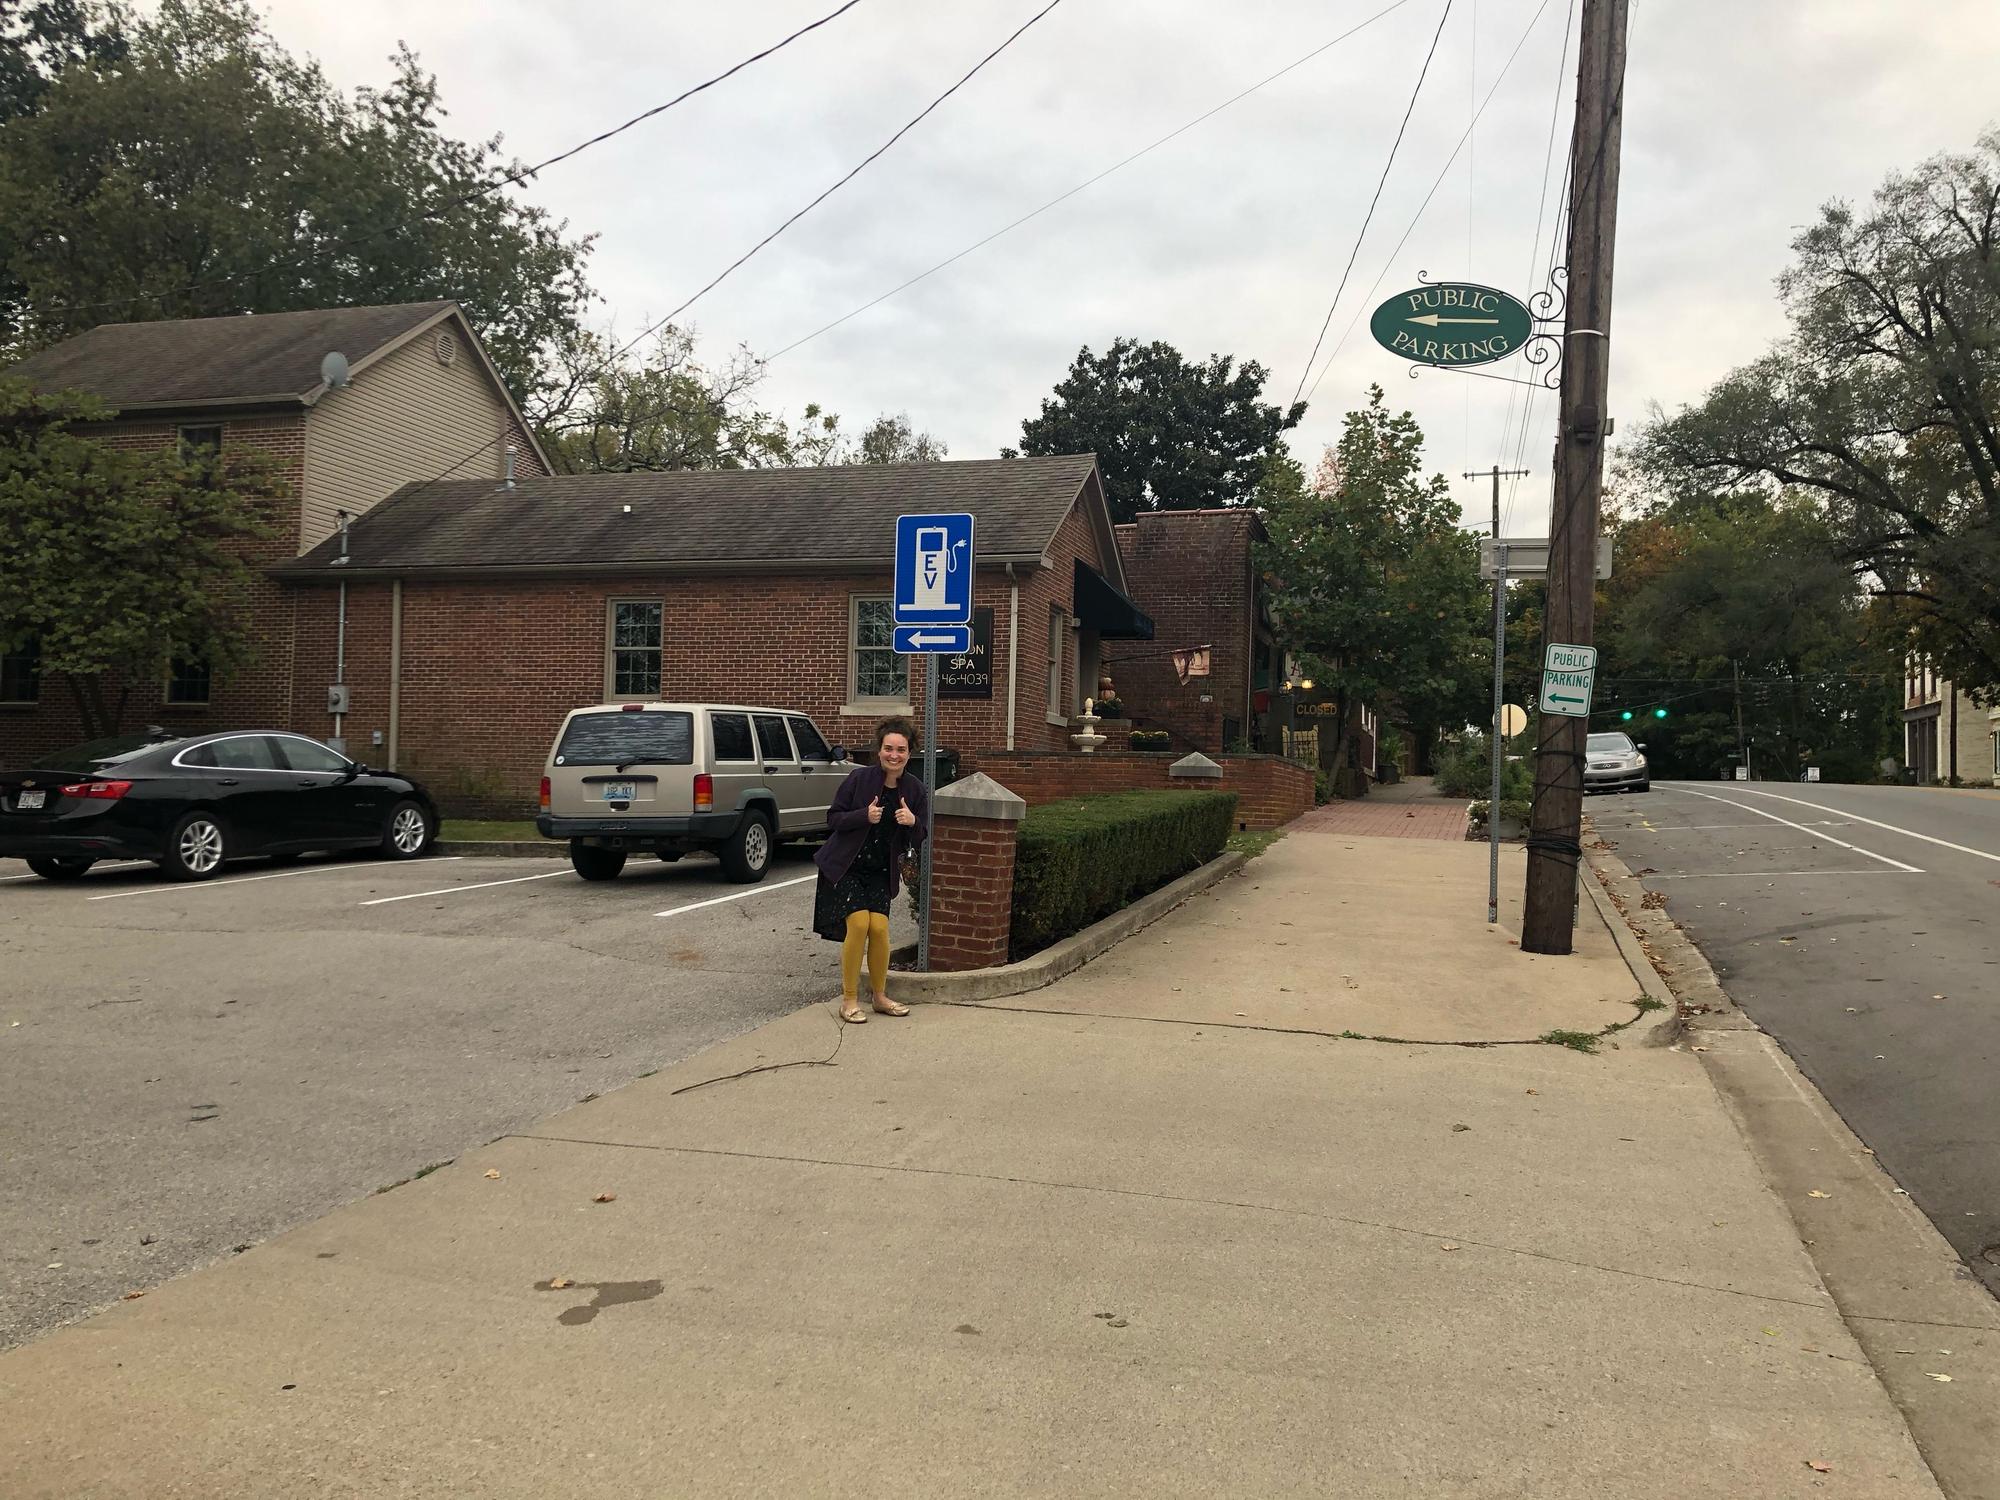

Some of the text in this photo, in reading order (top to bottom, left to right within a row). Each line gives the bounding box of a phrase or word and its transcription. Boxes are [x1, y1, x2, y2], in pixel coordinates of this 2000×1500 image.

[1408, 289, 1499, 312] PUBLIC
[1390, 330, 1509, 360] PARKING
[924, 554, 938, 590] EV
[950, 658, 975, 670] SPA
[1553, 652, 1589, 668] PUBLIC
[937, 673, 988, 685] 46-4039
[1546, 672, 1590, 689] PARKING
[1296, 703, 1338, 716] CLOSED
